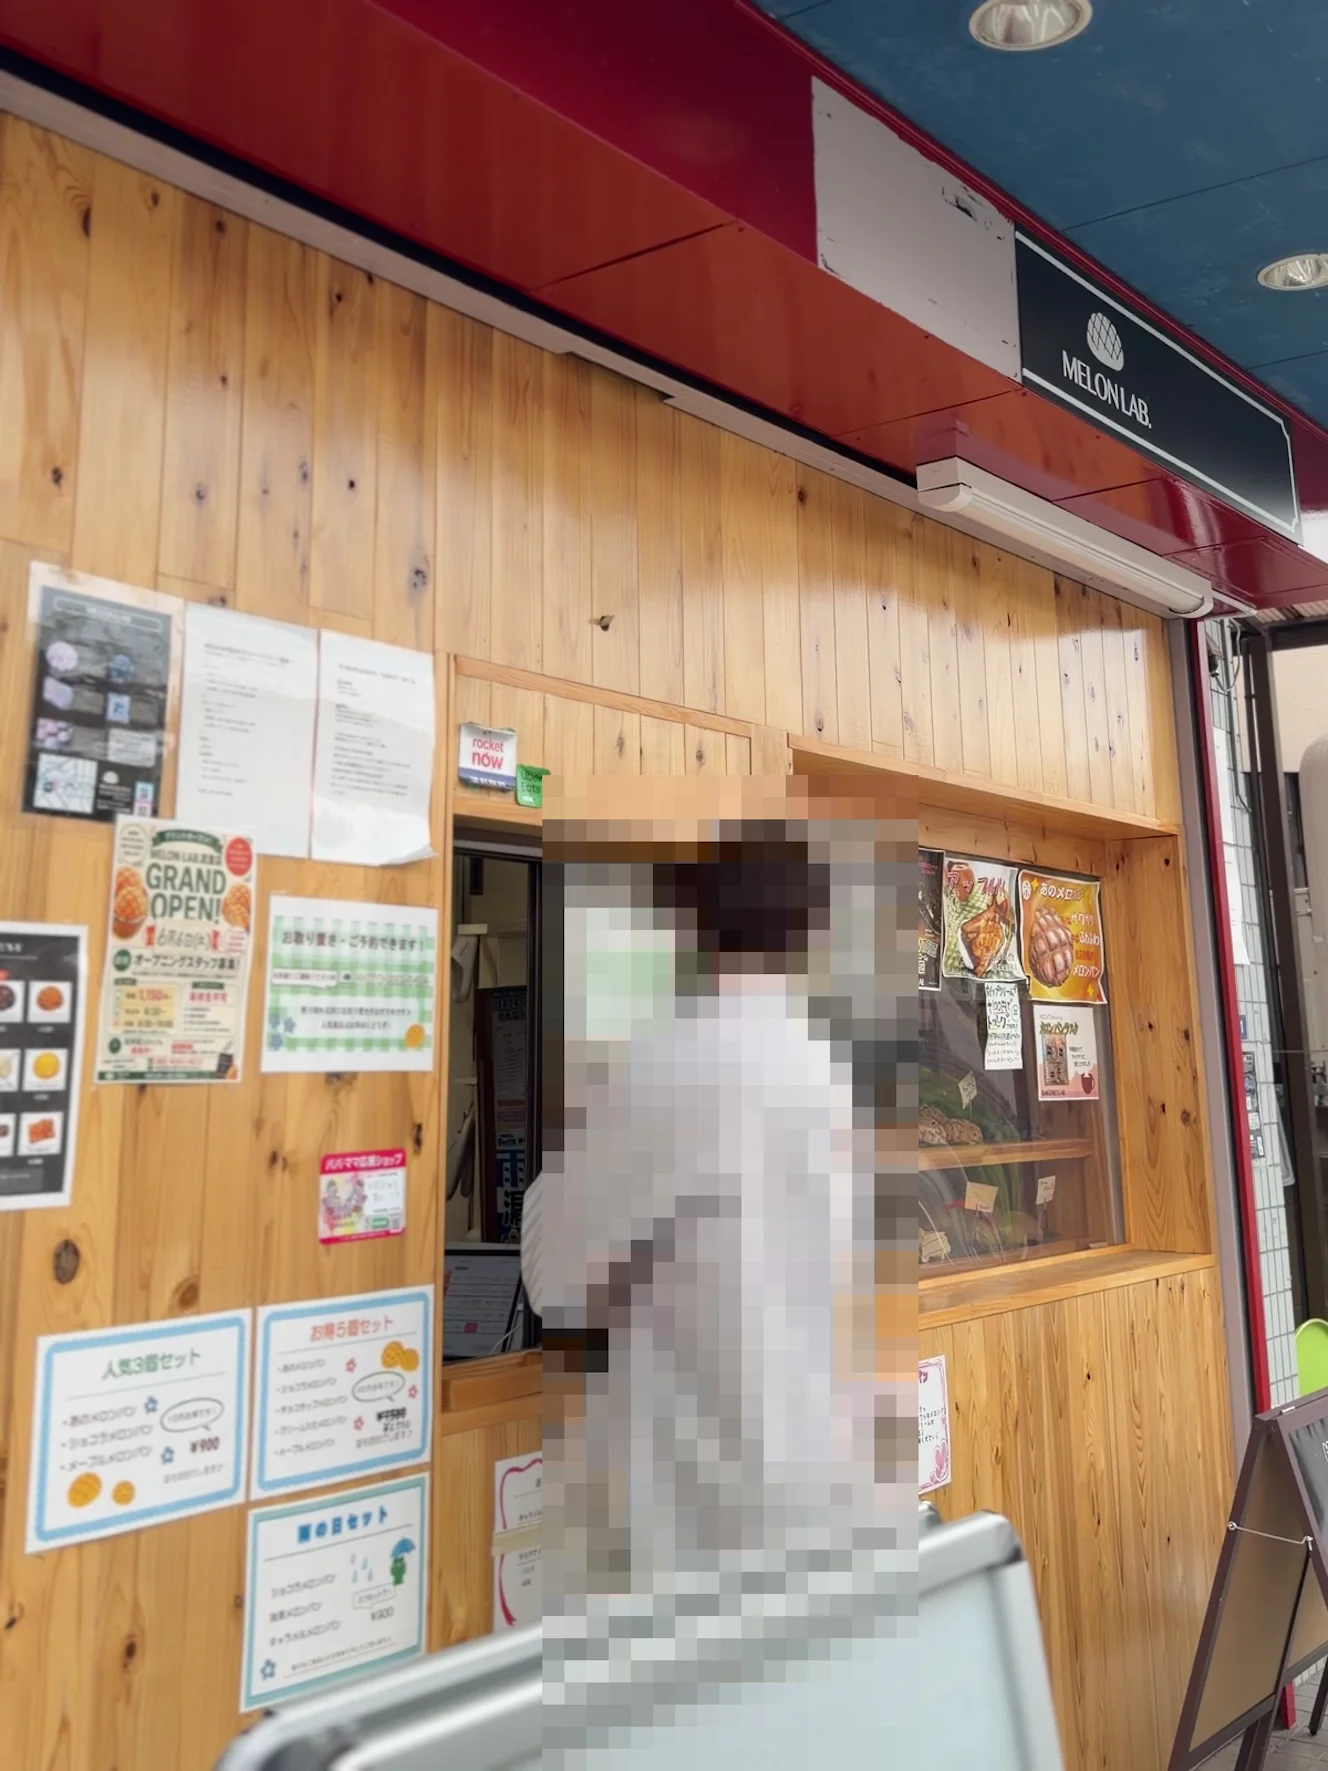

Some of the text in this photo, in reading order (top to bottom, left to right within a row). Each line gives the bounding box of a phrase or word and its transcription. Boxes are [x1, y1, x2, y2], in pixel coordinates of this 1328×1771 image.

[1062, 350, 1152, 430] MELON LAB.
[472, 738, 504, 753] rocket
[472, 752, 503, 769] now
[147, 863, 227, 895] GRAND
[151, 893, 220, 924] OPEN!
[102, 1348, 201, 1380] 人気3個セット
